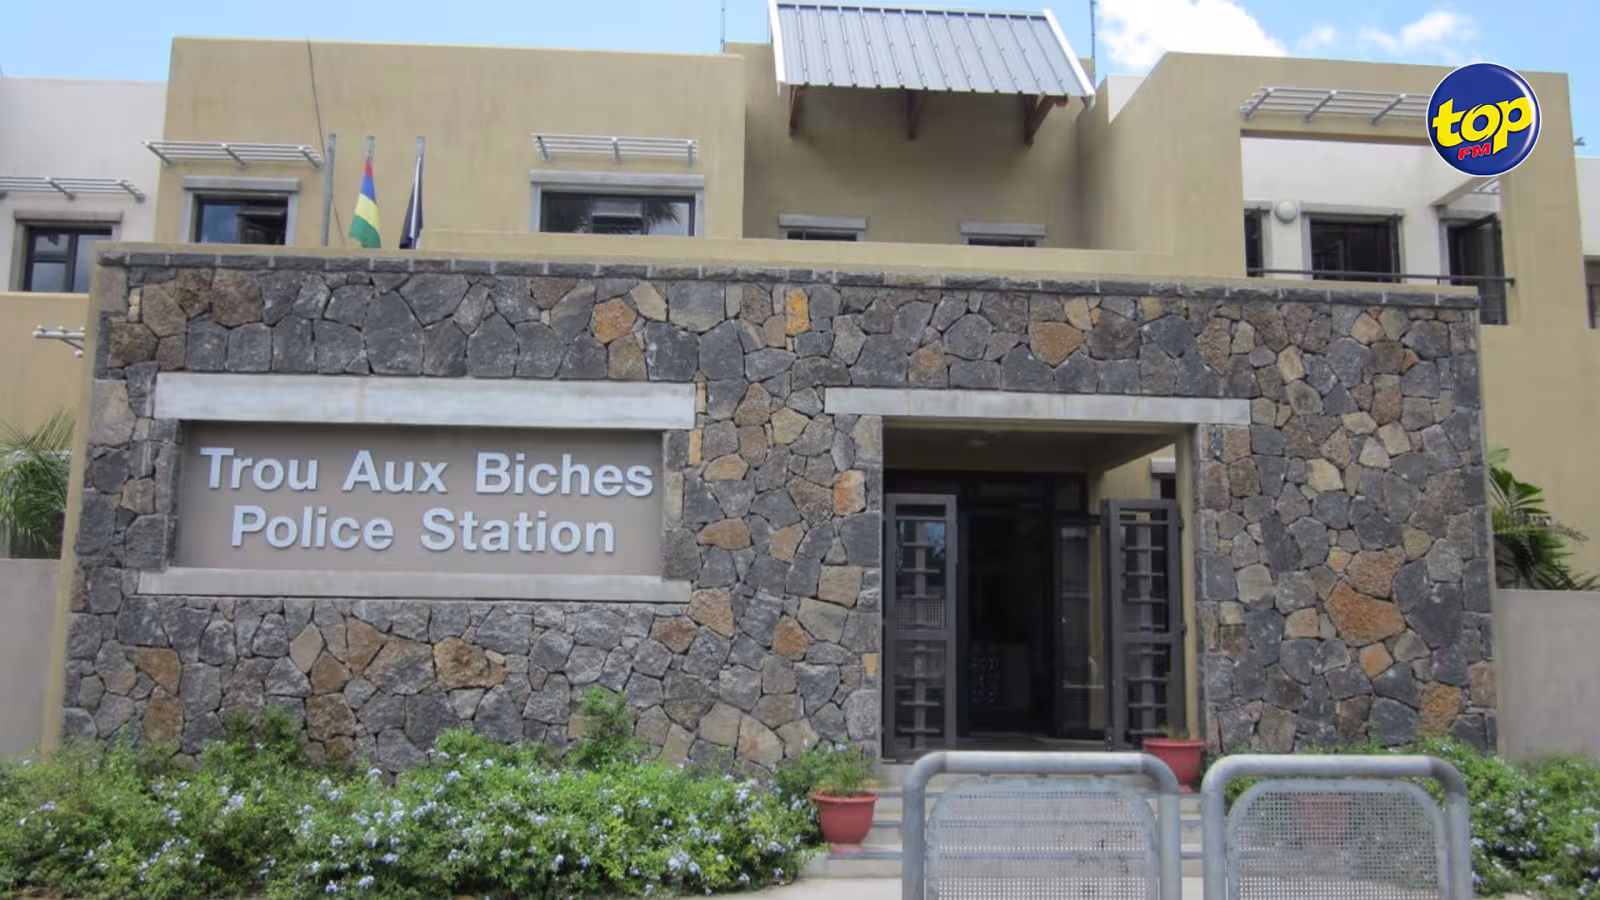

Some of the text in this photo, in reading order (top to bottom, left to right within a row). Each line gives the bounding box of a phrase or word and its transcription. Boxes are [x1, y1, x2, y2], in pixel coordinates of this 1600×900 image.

[200, 447, 654, 497] Trou Aux Biches
[231, 504, 615, 554] Police Station
